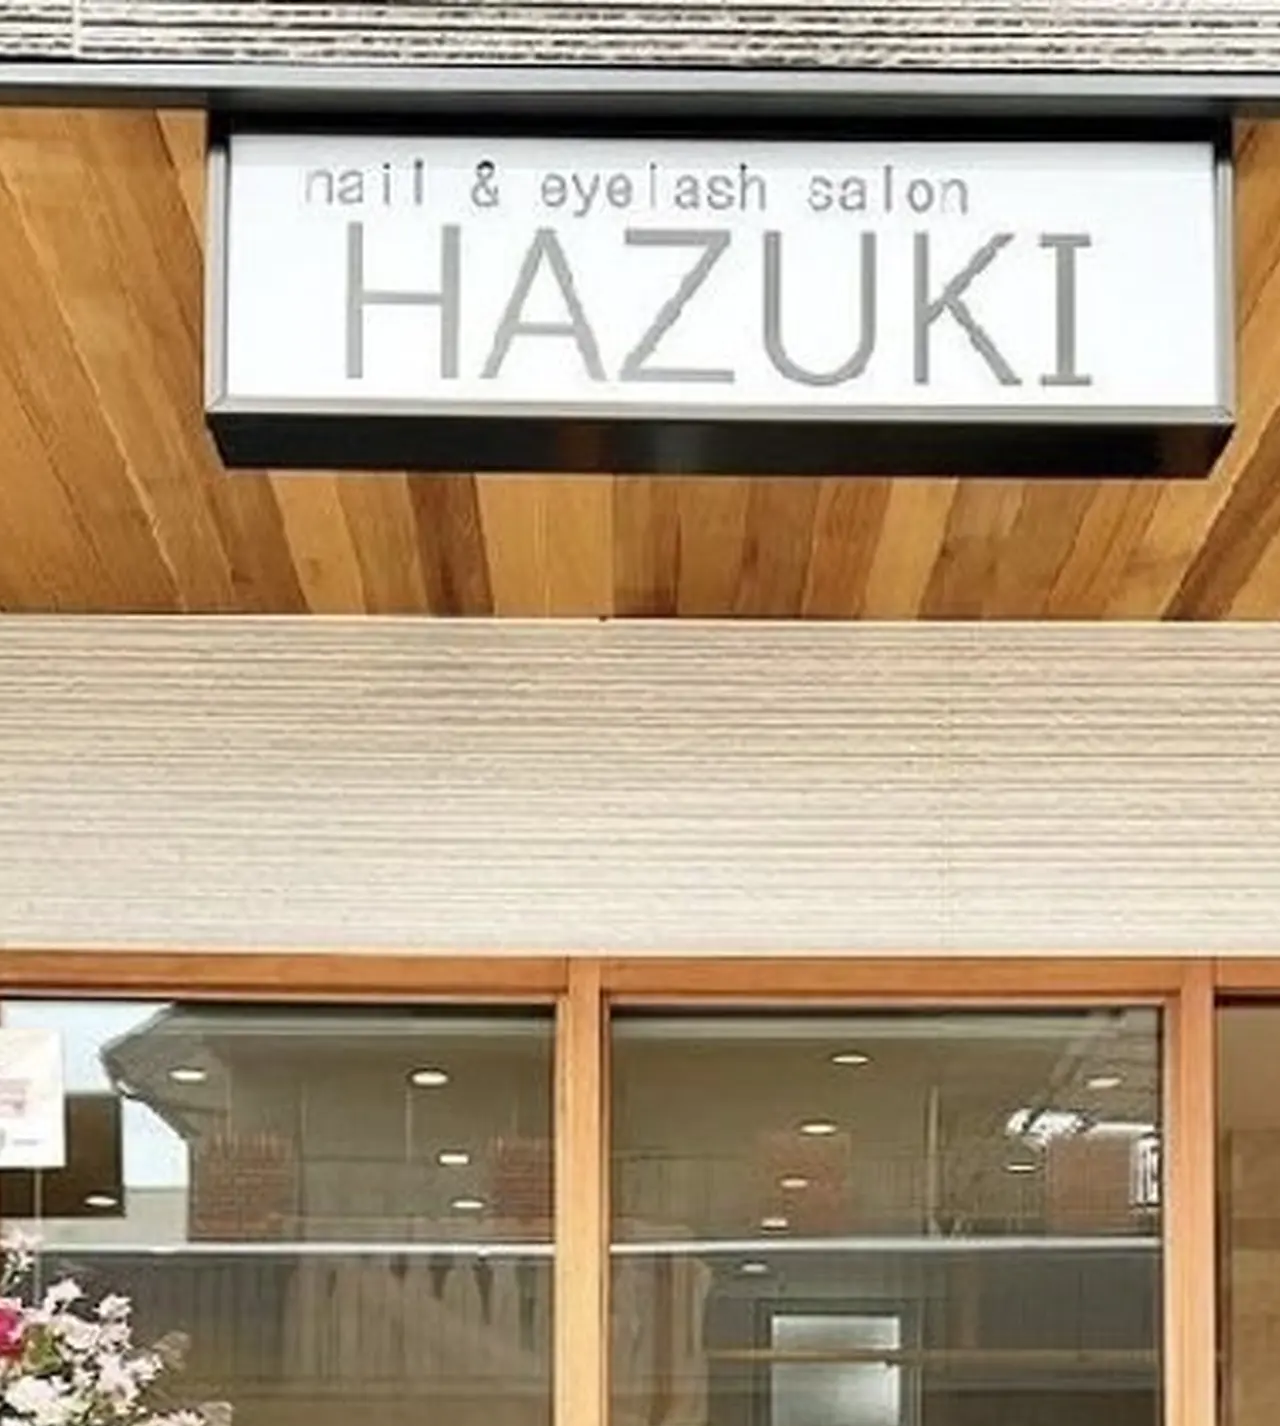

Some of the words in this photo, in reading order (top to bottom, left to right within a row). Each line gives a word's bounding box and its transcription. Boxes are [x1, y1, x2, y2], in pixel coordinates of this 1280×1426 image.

[303, 160, 426, 207] nail
[470, 160, 501, 208] &
[539, 163, 767, 219] eyelash
[807, 166, 970, 215] salon
[343, 221, 1094, 387] HAZUKI
